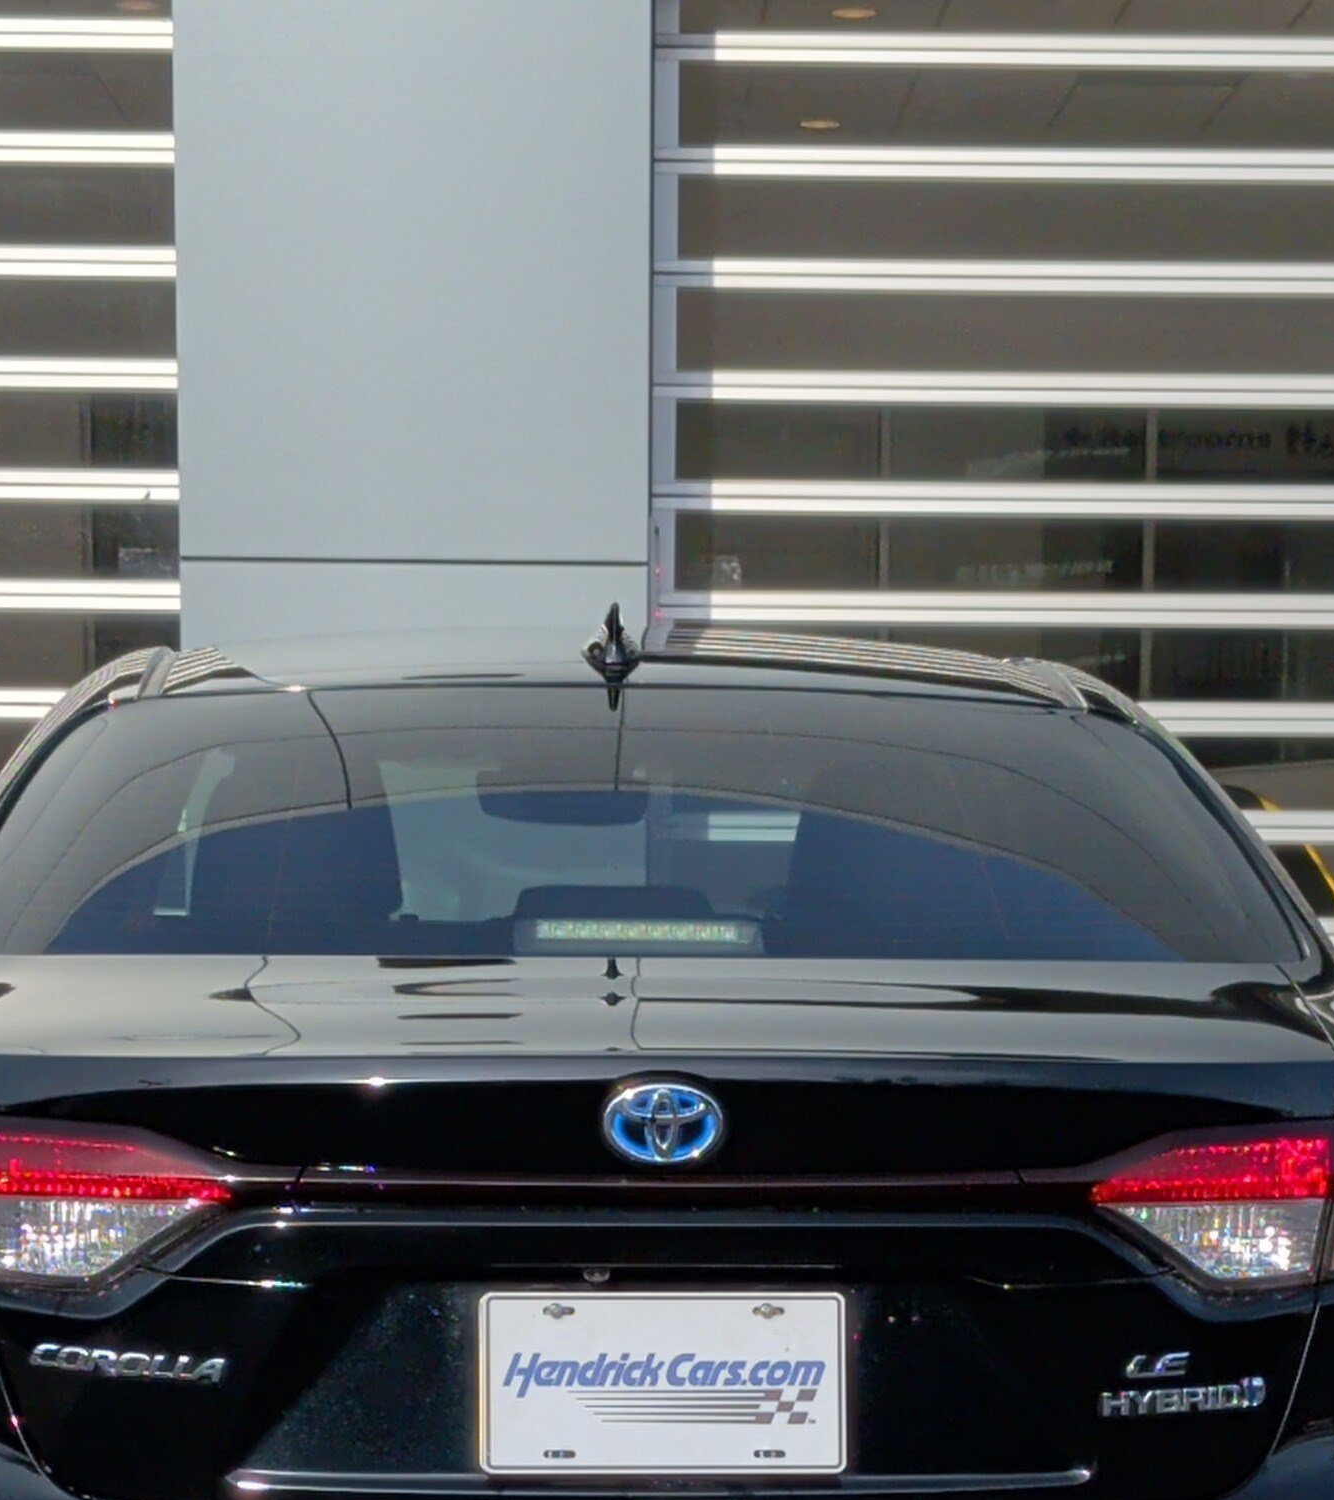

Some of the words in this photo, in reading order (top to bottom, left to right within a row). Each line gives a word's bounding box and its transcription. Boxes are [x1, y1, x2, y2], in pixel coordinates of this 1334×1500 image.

[28, 1343, 225, 1383] COROLLA
[502, 1352, 826, 1398] HendrickCars.com
[1125, 1351, 1190, 1379] LE
[1099, 1384, 1242, 1417] HYBRID
